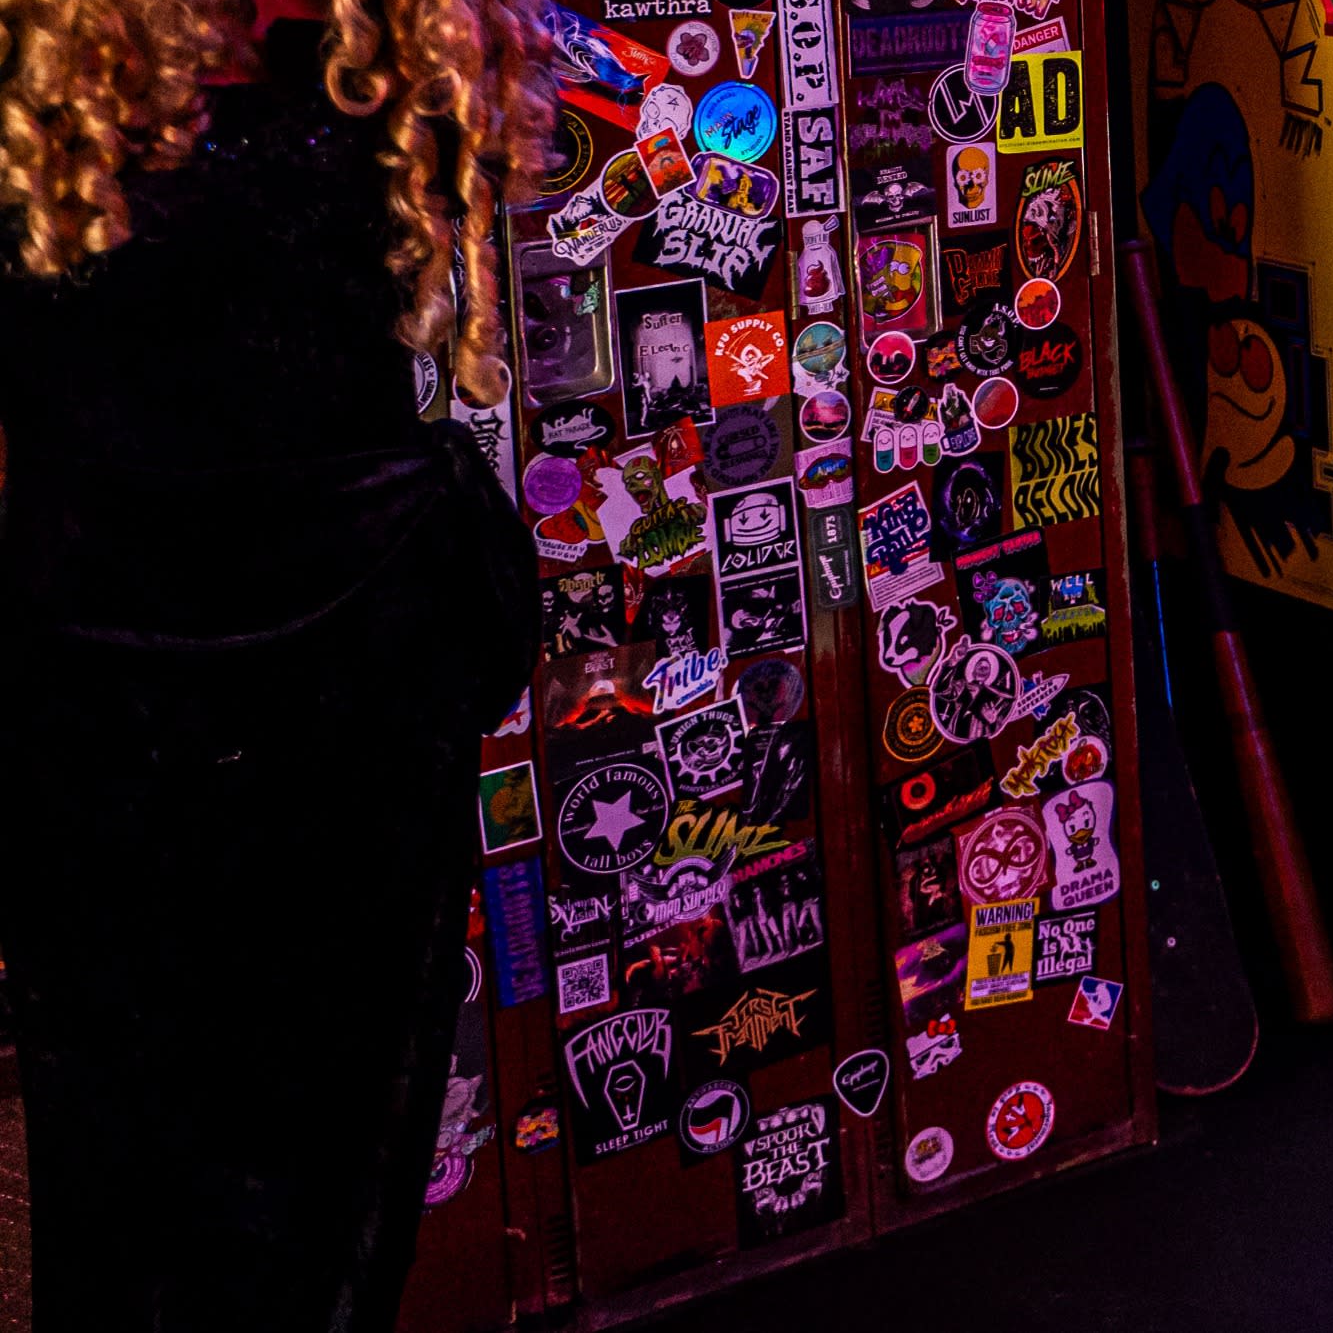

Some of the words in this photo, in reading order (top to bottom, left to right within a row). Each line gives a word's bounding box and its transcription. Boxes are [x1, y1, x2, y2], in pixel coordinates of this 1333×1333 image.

[1012, 25, 1059, 51] DANGER
[1001, 58, 1082, 140] AD
[784, 111, 794, 145] STAND
[784, 146, 795, 182] AGAINST
[785, 183, 796, 215] FEAR
[952, 208, 991, 224] SUNLUST
[729, 319, 773, 334] SUPPLY
[1018, 340, 1076, 366] BLACK
[1011, 414, 1098, 484] BONES
[1014, 468, 1100, 529] BELOW
[1051, 573, 1095, 590] WELL
[606, 768, 660, 802] famous
[653, 808, 793, 866] SLIME
[584, 852, 611, 869] tall
[617, 839, 654, 867] boys
[1060, 868, 1114, 897] DRAMA
[1062, 881, 1115, 908] QUEEN
[975, 901, 1034, 927] WARNING!
[1038, 923, 1061, 940] No
[1063, 918, 1095, 935] One
[1042, 939, 1058, 956] is
[594, 1133, 631, 1155] SLEEP
[633, 1119, 669, 1140] TIGHT
[742, 1138, 830, 1193] BEAST
